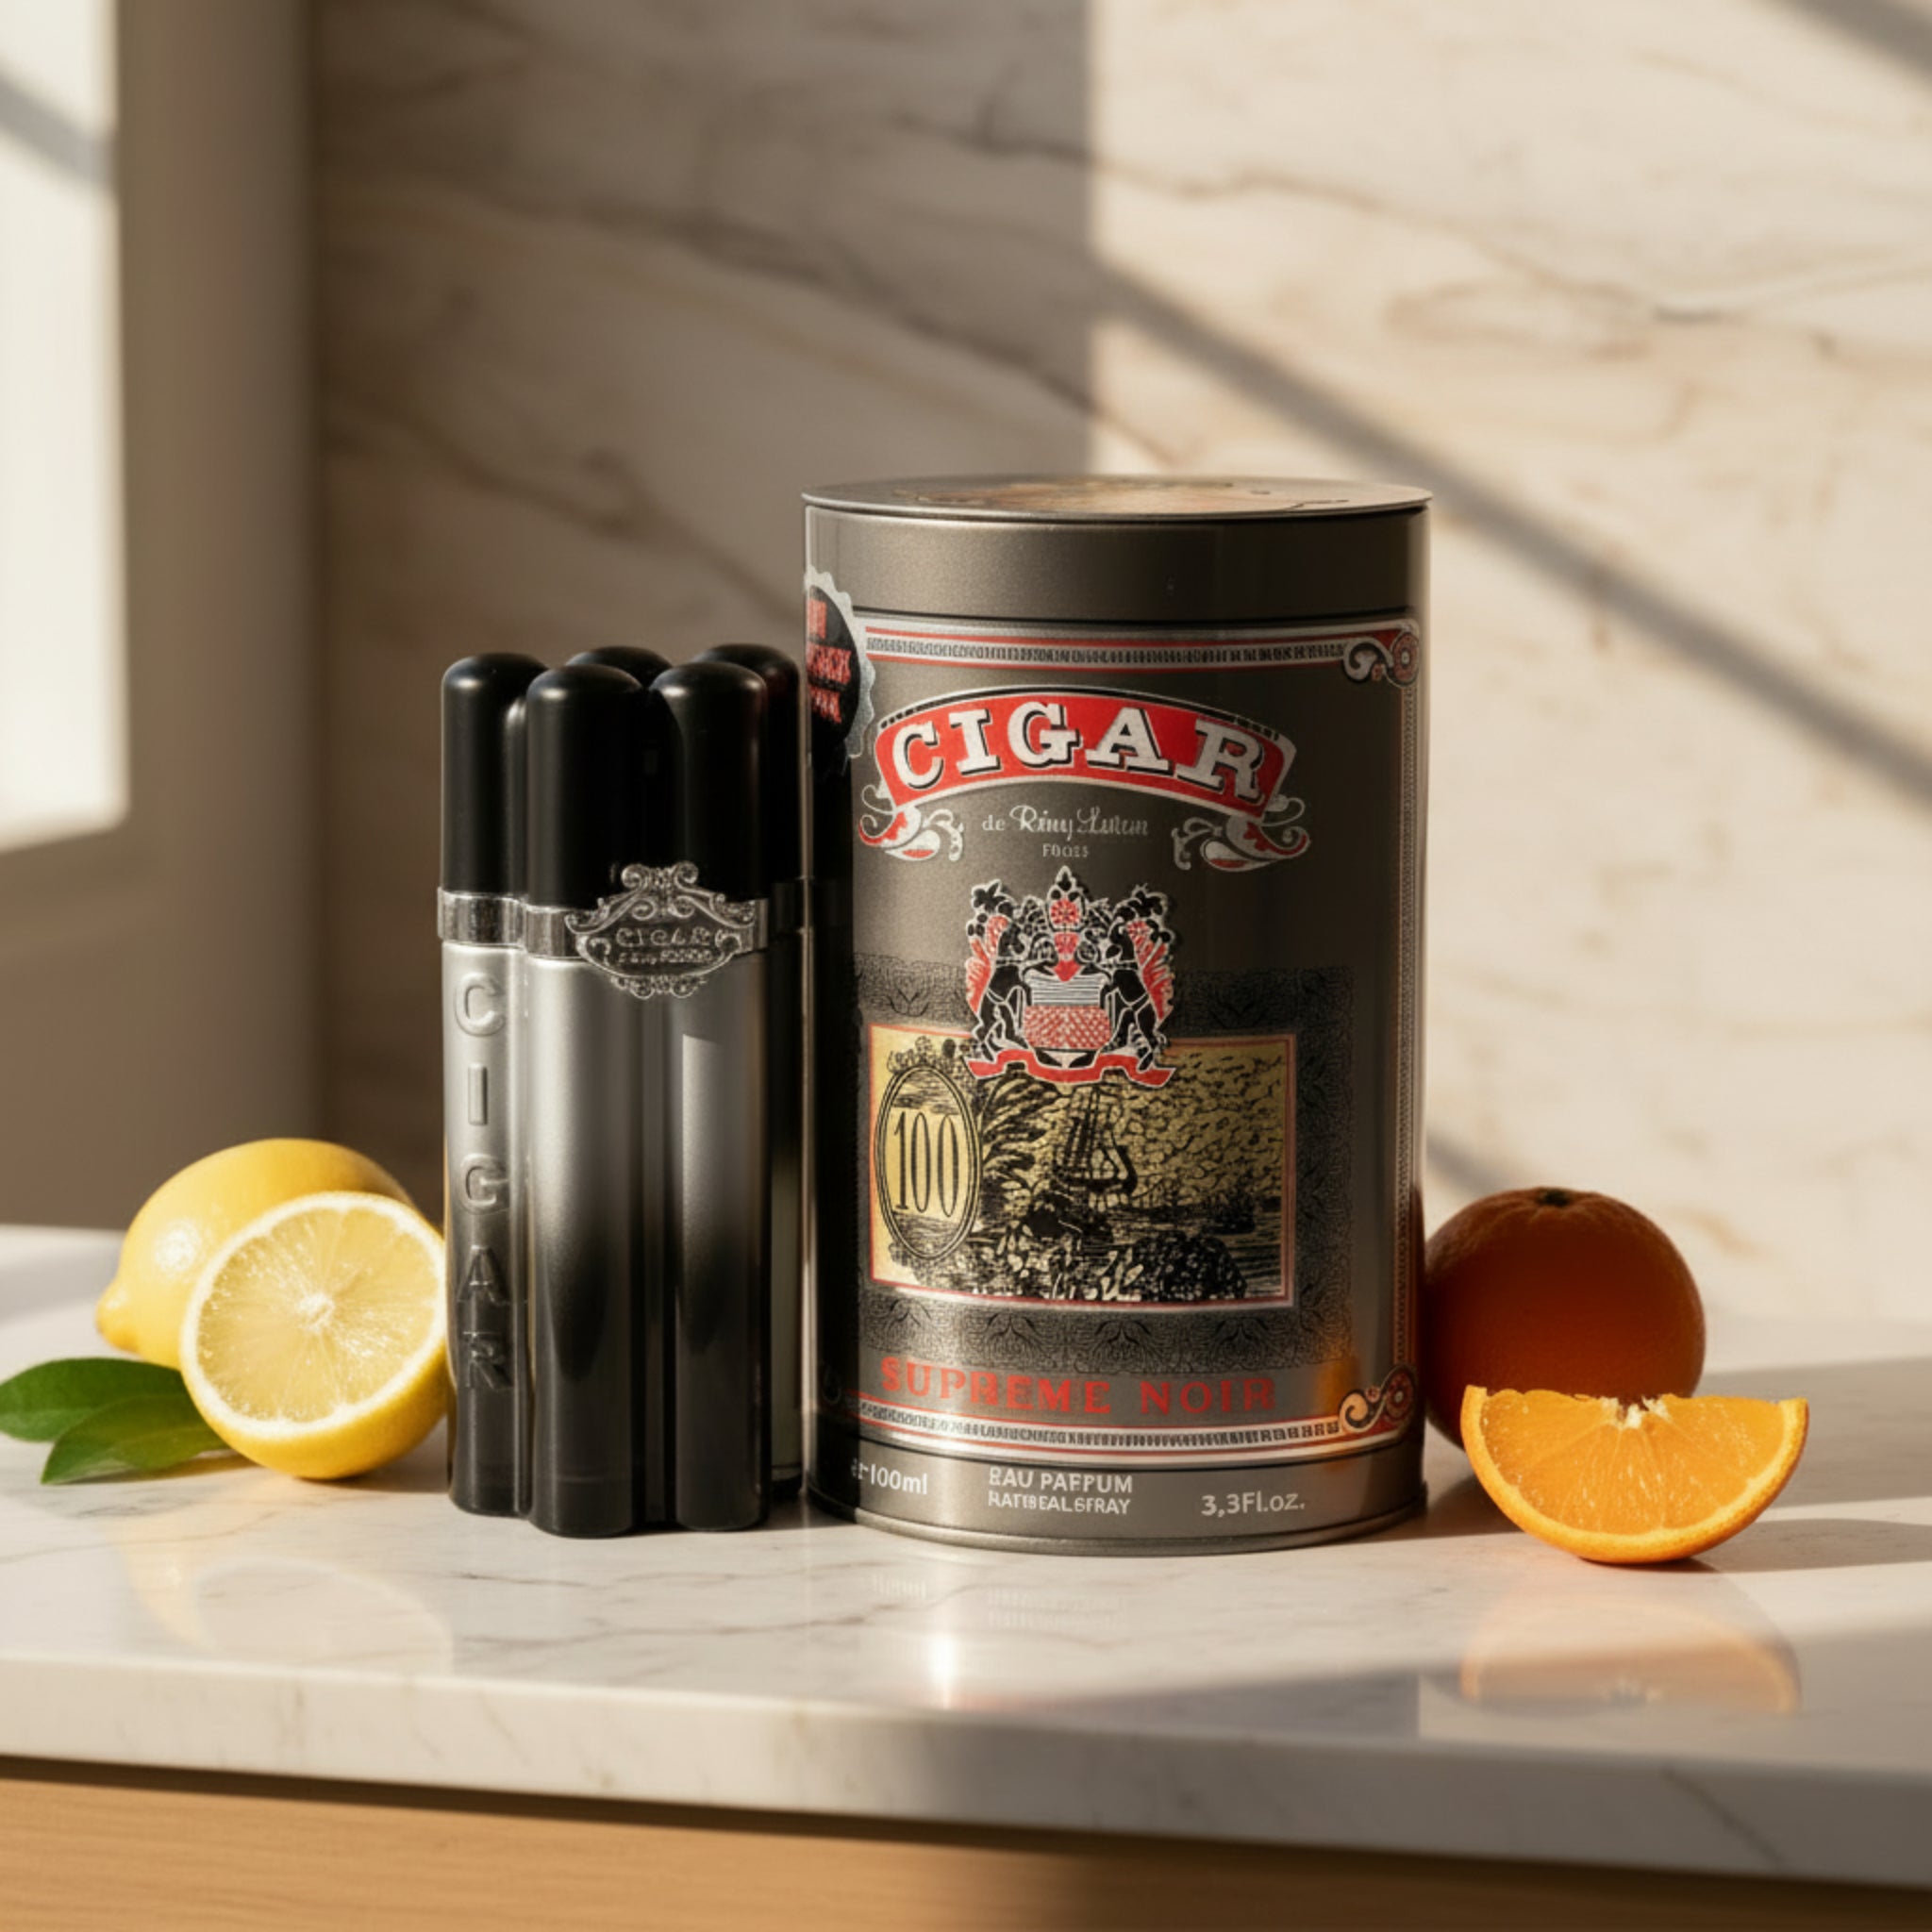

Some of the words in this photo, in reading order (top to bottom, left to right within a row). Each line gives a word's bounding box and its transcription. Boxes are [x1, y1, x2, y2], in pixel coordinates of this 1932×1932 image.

[891, 700, 1266, 805] CIGAR
[981, 814, 1006, 832] de
[454, 971, 512, 1391] CIGAR
[893, 1110, 959, 1218] 100
[880, 1356, 1111, 1414] SUPREME
[1140, 1377, 1276, 1415] NOIR
